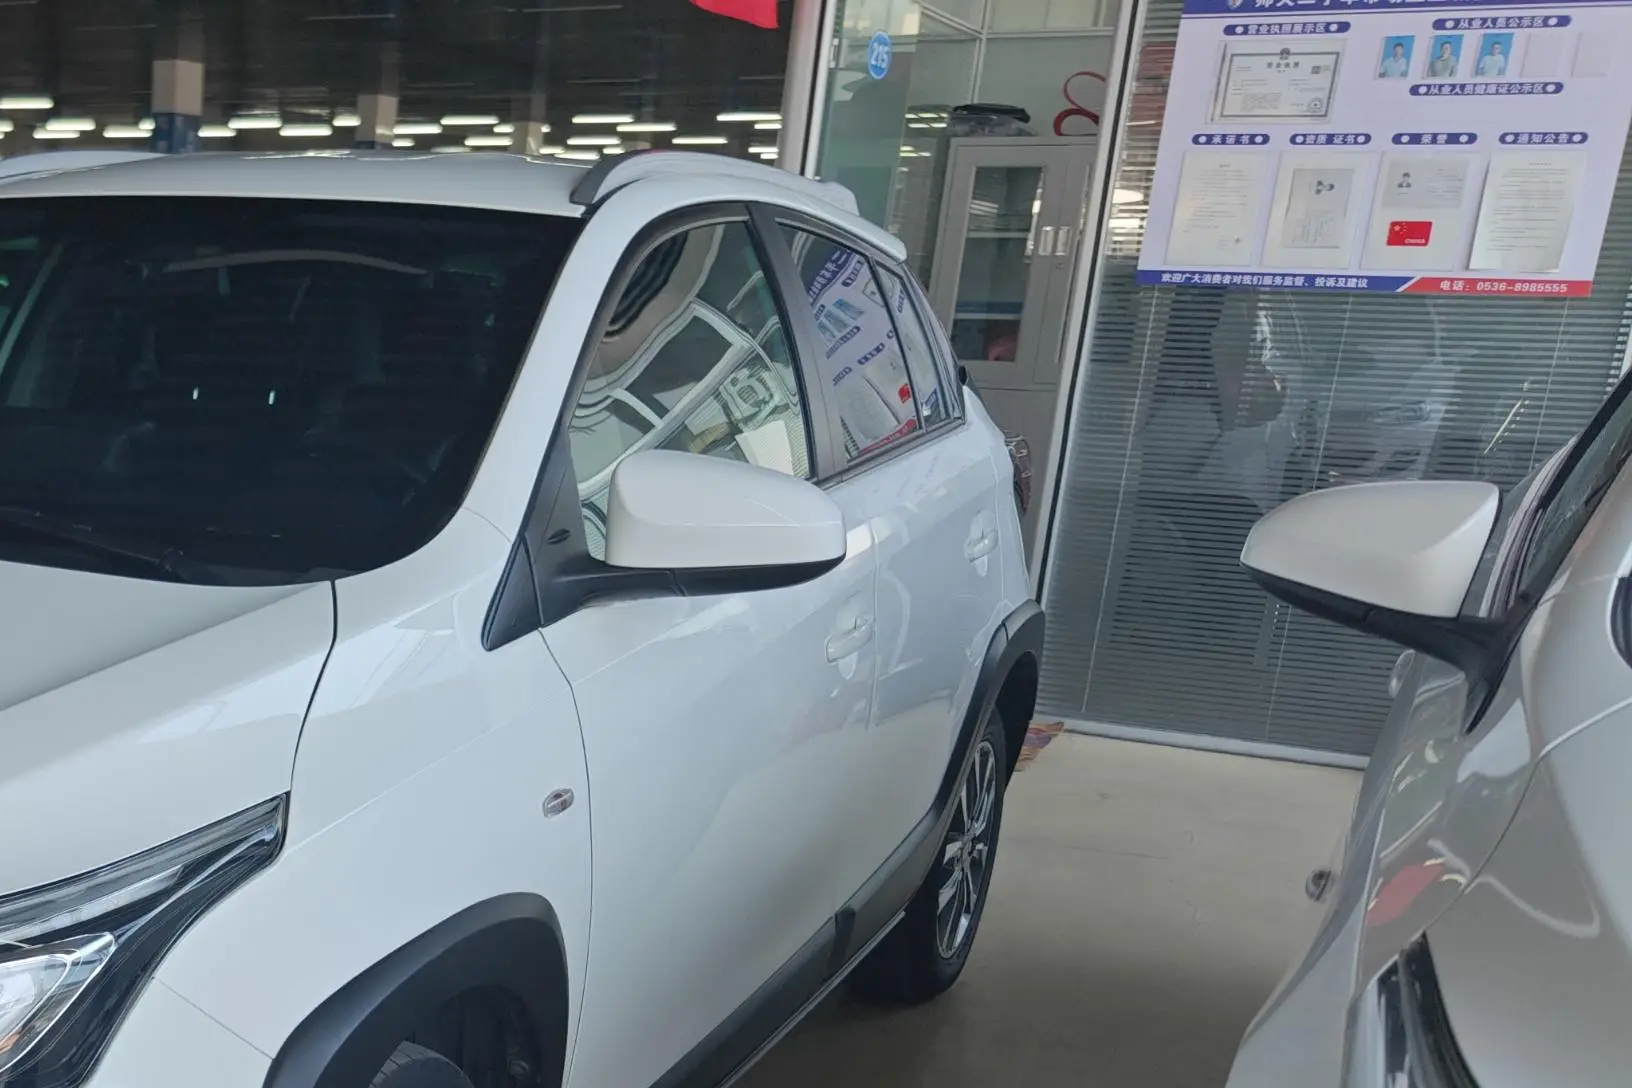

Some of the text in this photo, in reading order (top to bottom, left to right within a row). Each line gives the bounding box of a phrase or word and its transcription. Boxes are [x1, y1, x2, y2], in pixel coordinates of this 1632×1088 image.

[1247, 23, 1327, 35] 营业执照展示区
[1457, 17, 1545, 29] 从业人员公示区
[871, 42, 889, 69] 215
[1517, 132, 1570, 144] 通知公告
